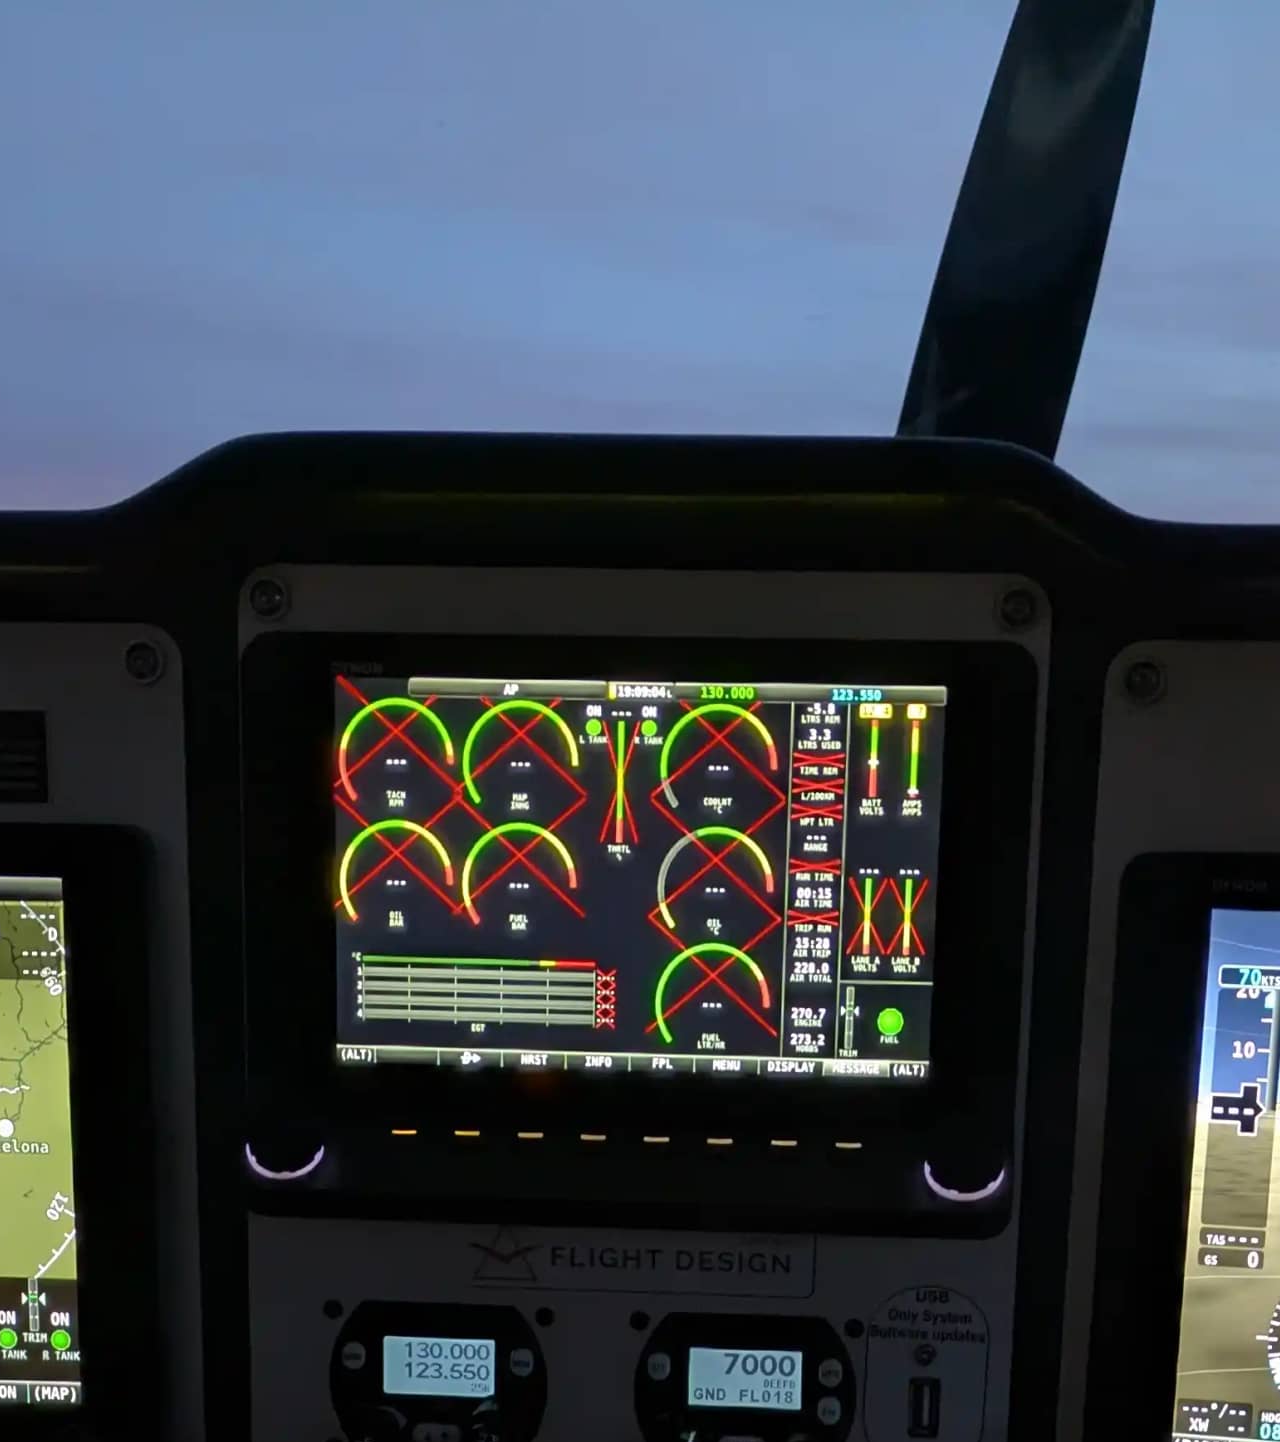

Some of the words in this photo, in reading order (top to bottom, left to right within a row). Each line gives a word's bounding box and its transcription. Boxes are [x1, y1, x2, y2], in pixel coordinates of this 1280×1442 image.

[504, 684, 518, 695] AP
[701, 687, 754, 699] 130.000
[832, 689, 882, 700] 123.550
[587, 706, 601, 716] ON
[642, 706, 657, 717] ON
[809, 729, 831, 740] 3.3
[797, 888, 832, 899] 00:15
[795, 938, 830, 949] 15:28
[791, 1008, 826, 1019] 270.7
[794, 1019, 822, 1027] ENGINE
[790, 1034, 825, 1045] 273.2
[880, 1036, 898, 1044] FUEL
[341, 1049, 372, 1062] (ALT)
[521, 1053, 547, 1066] NRST
[585, 1056, 612, 1068] INFO
[653, 1059, 673, 1068] FPL
[713, 1060, 740, 1070] MENU
[768, 1062, 815, 1073] DISPLAY
[833, 1063, 879, 1074] MESSAGE
[893, 1064, 925, 1077] (ALT)
[550, 1246, 663, 1270] FLIGHT
[674, 1249, 792, 1273] DESIGN
[916, 1290, 950, 1303] USB
[51, 1312, 70, 1326] ON
[888, 1308, 919, 1326] Only
[923, 1309, 972, 1326] System
[23, 1333, 47, 1343] TRIM
[404, 1342, 490, 1361] 130.000
[723, 1354, 796, 1376] 7000
[404, 1362, 490, 1380] 123.550
[34, 1386, 76, 1403] (MAP)
[693, 1387, 727, 1402] GND
[739, 1388, 794, 1404] FL018
[1189, 1418, 1209, 1432] XW
